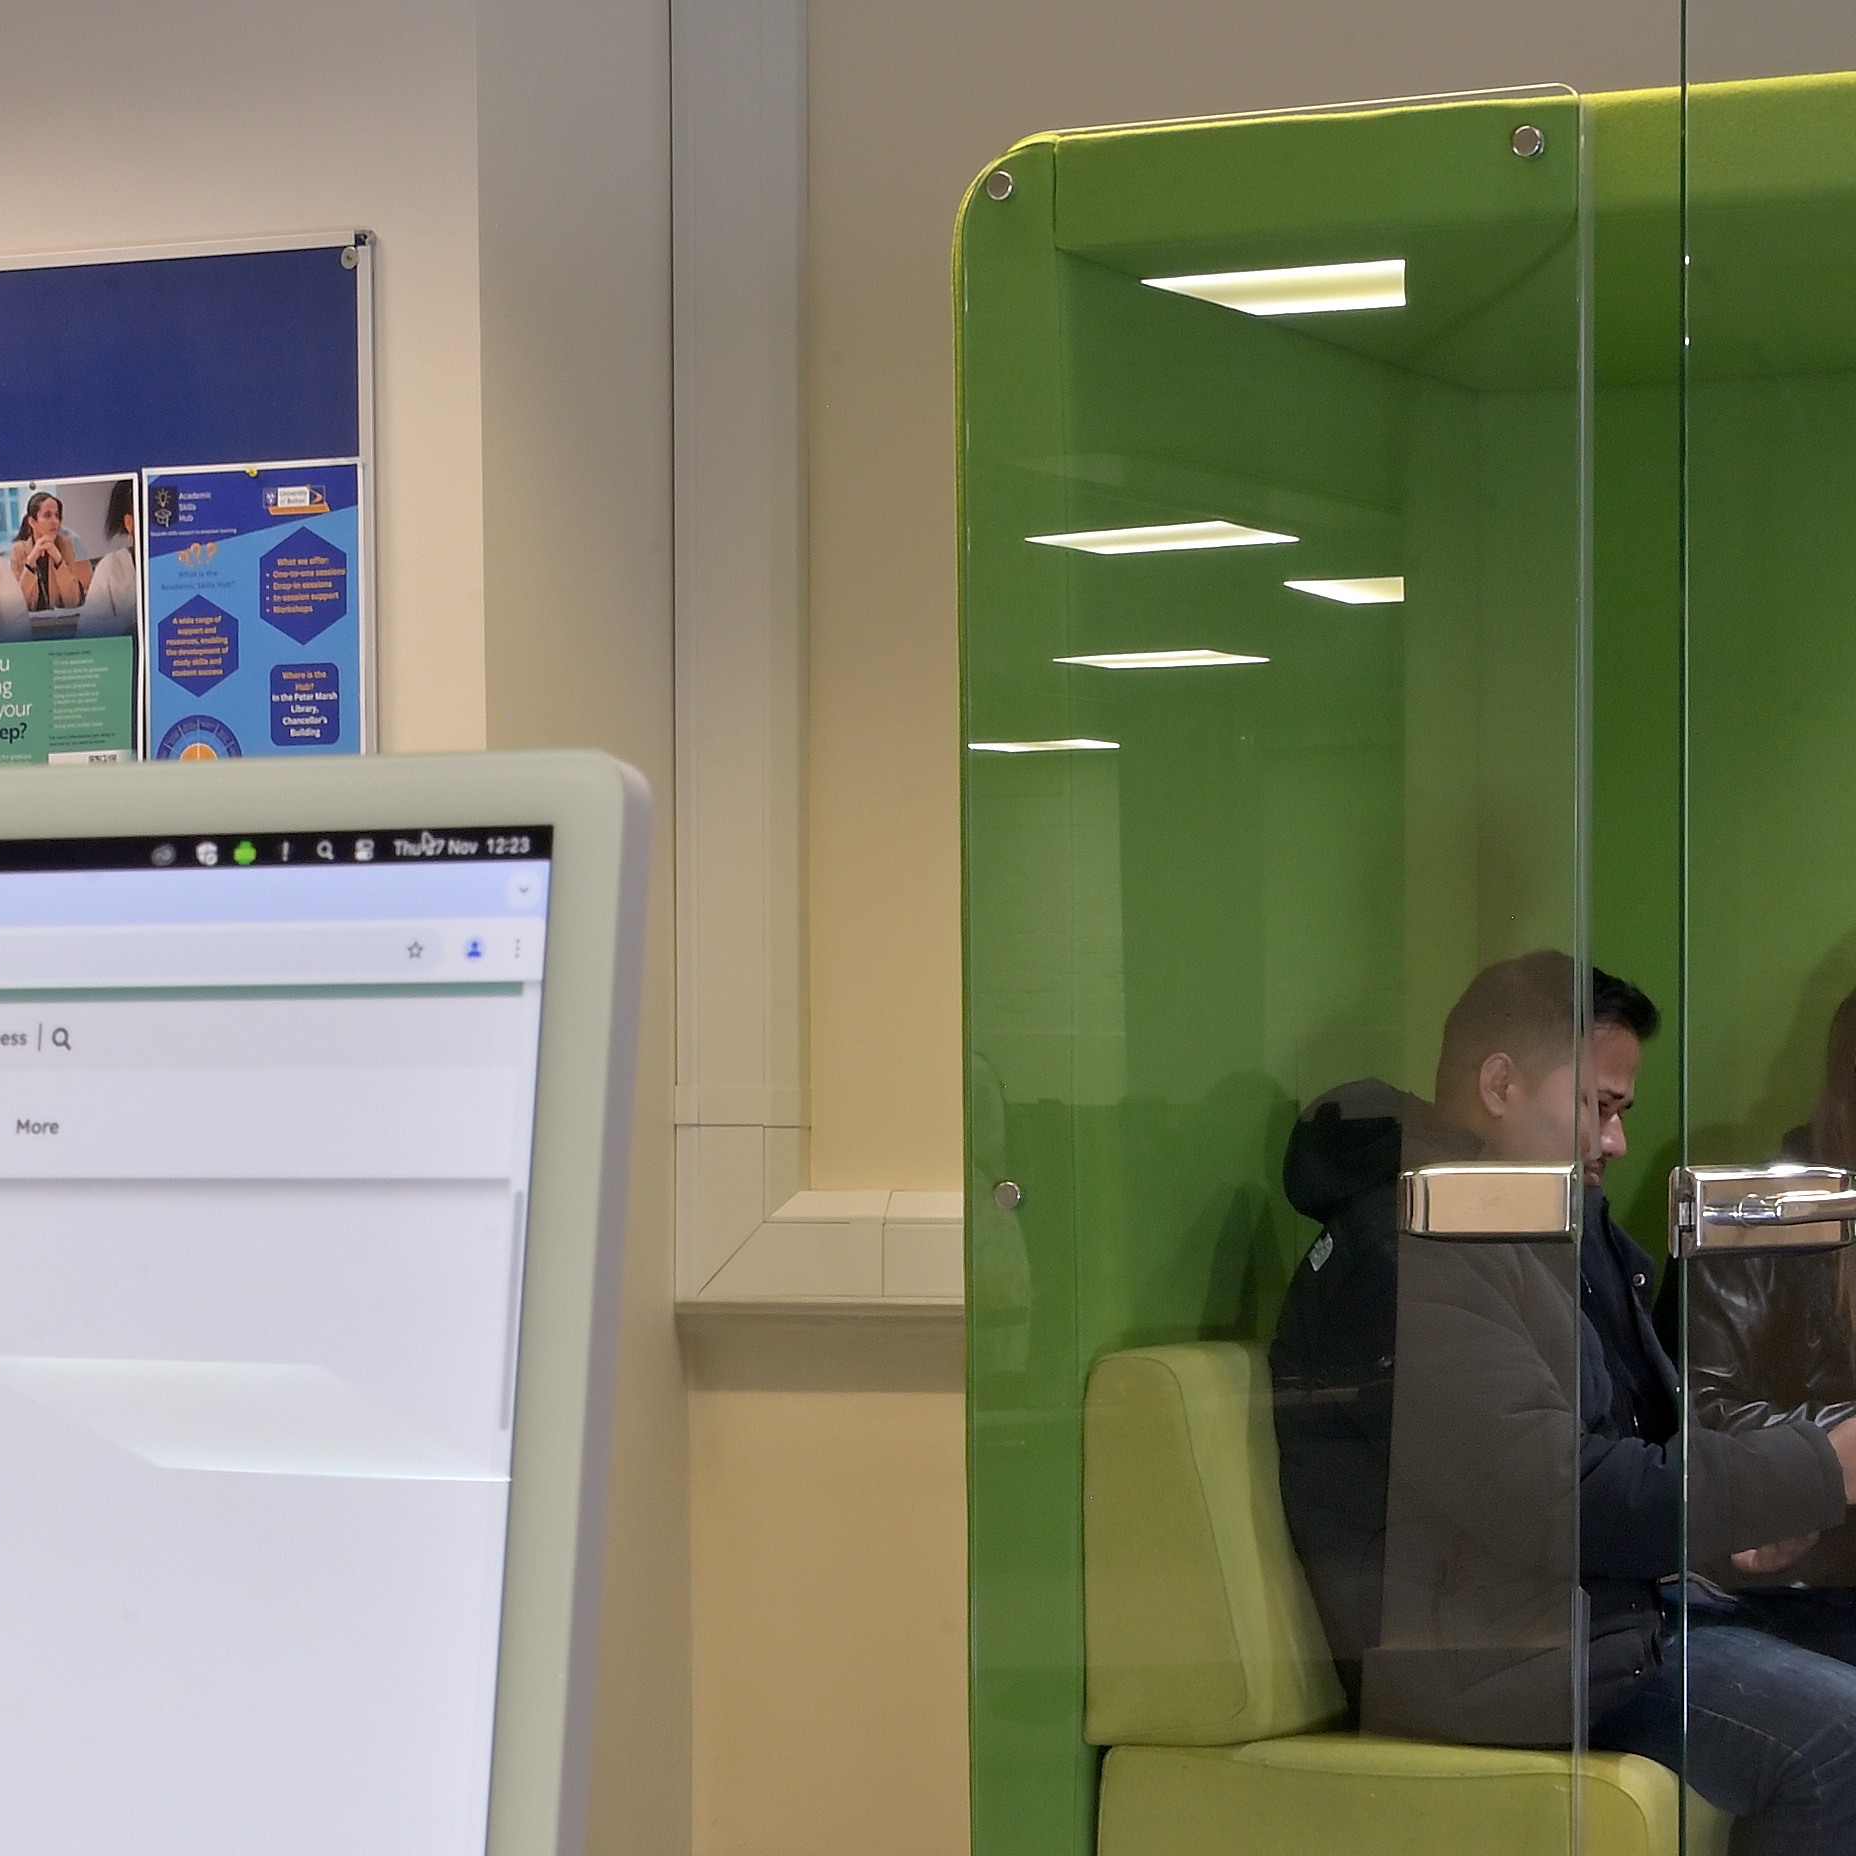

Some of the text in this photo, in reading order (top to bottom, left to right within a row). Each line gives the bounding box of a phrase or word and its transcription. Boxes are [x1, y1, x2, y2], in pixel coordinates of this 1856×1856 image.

[447, 838, 480, 855] Nov
[486, 835, 531, 855] 12:23
[16, 1118, 60, 1136] More
